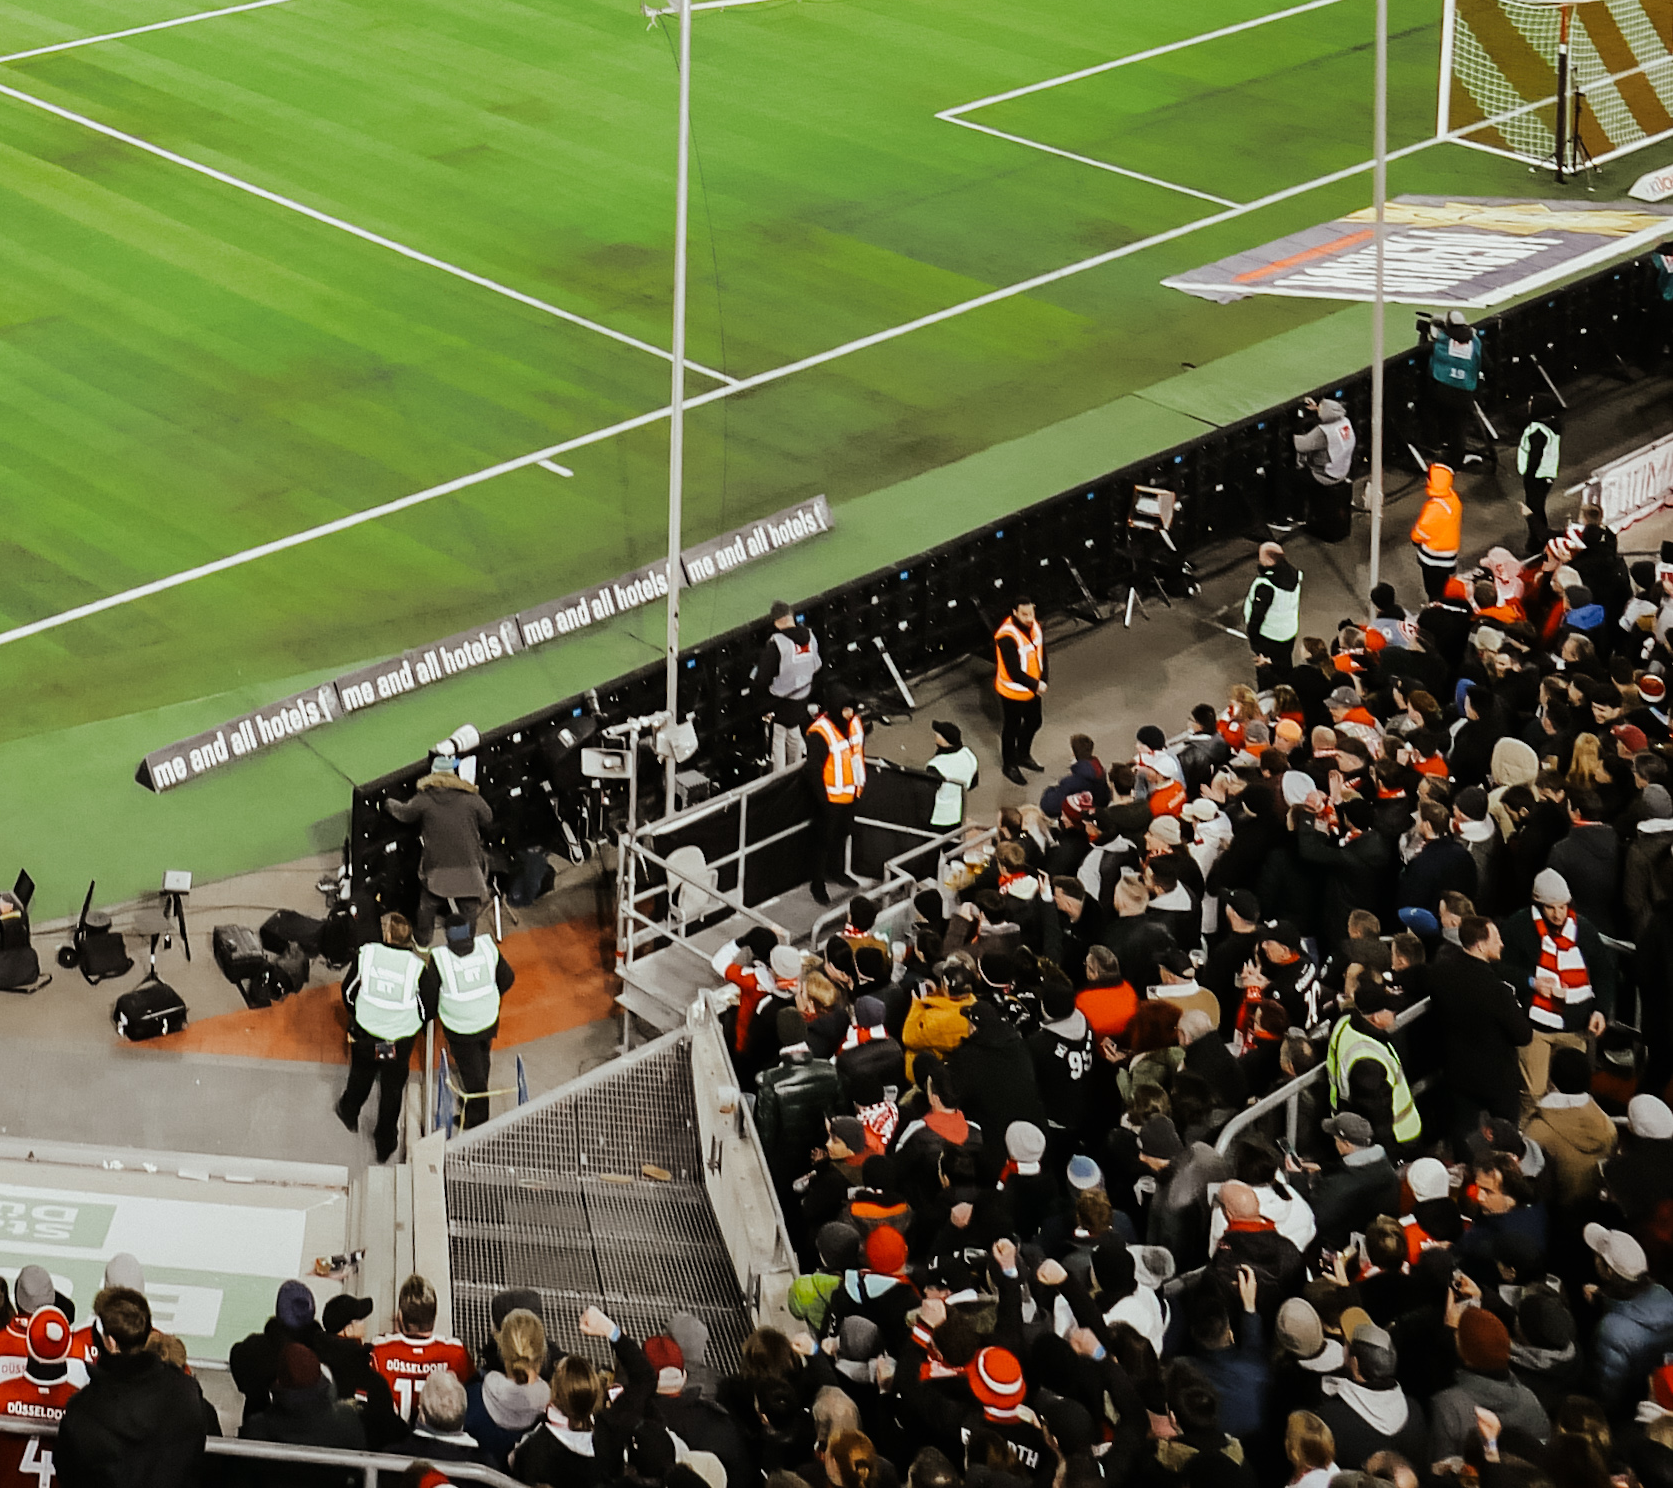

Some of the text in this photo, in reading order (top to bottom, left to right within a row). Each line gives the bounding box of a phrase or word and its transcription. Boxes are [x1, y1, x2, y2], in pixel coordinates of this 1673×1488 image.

[687, 507, 814, 582] me and all hotels
[522, 570, 670, 645] me and all hotels
[342, 632, 502, 710] me and all hotels
[153, 701, 321, 789] me and all hotels
[7, 1401, 66, 1421] DÜSSELDO
